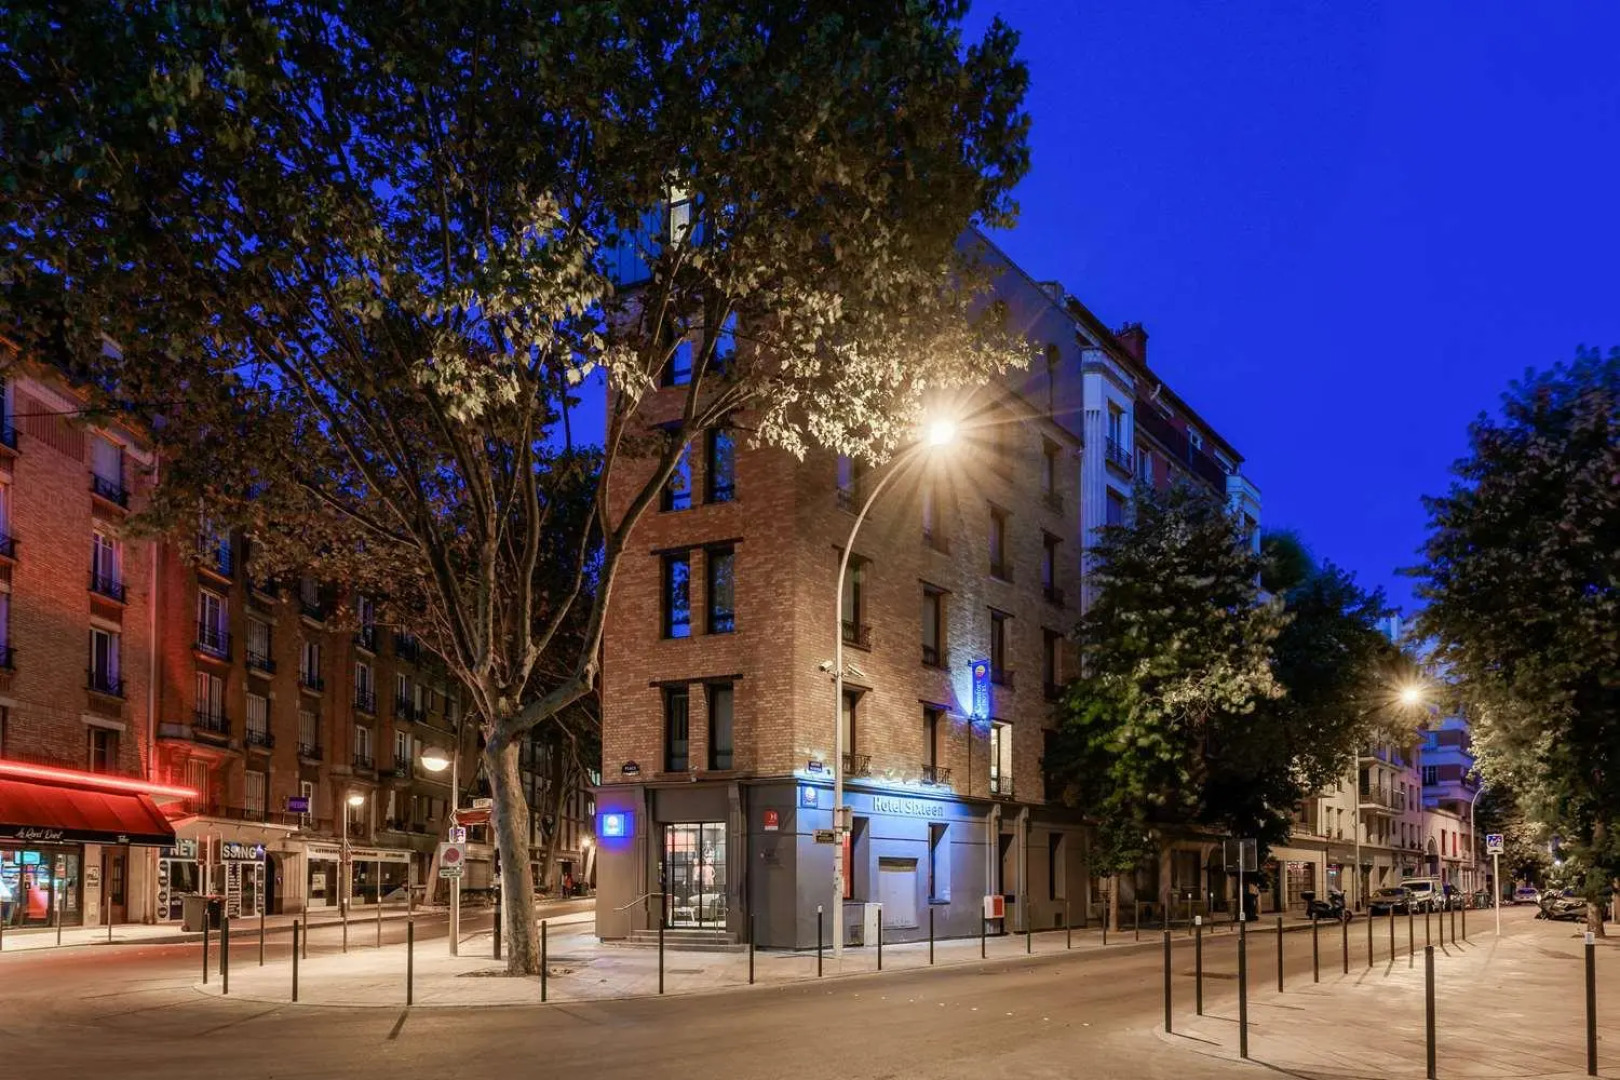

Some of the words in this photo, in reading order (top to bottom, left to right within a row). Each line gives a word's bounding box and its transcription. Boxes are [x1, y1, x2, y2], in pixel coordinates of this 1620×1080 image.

[873, 796, 903, 814] Hotel
[904, 799, 944, 817] Sixteen
[170, 841, 196, 857] NET
[223, 844, 257, 860] SSING
